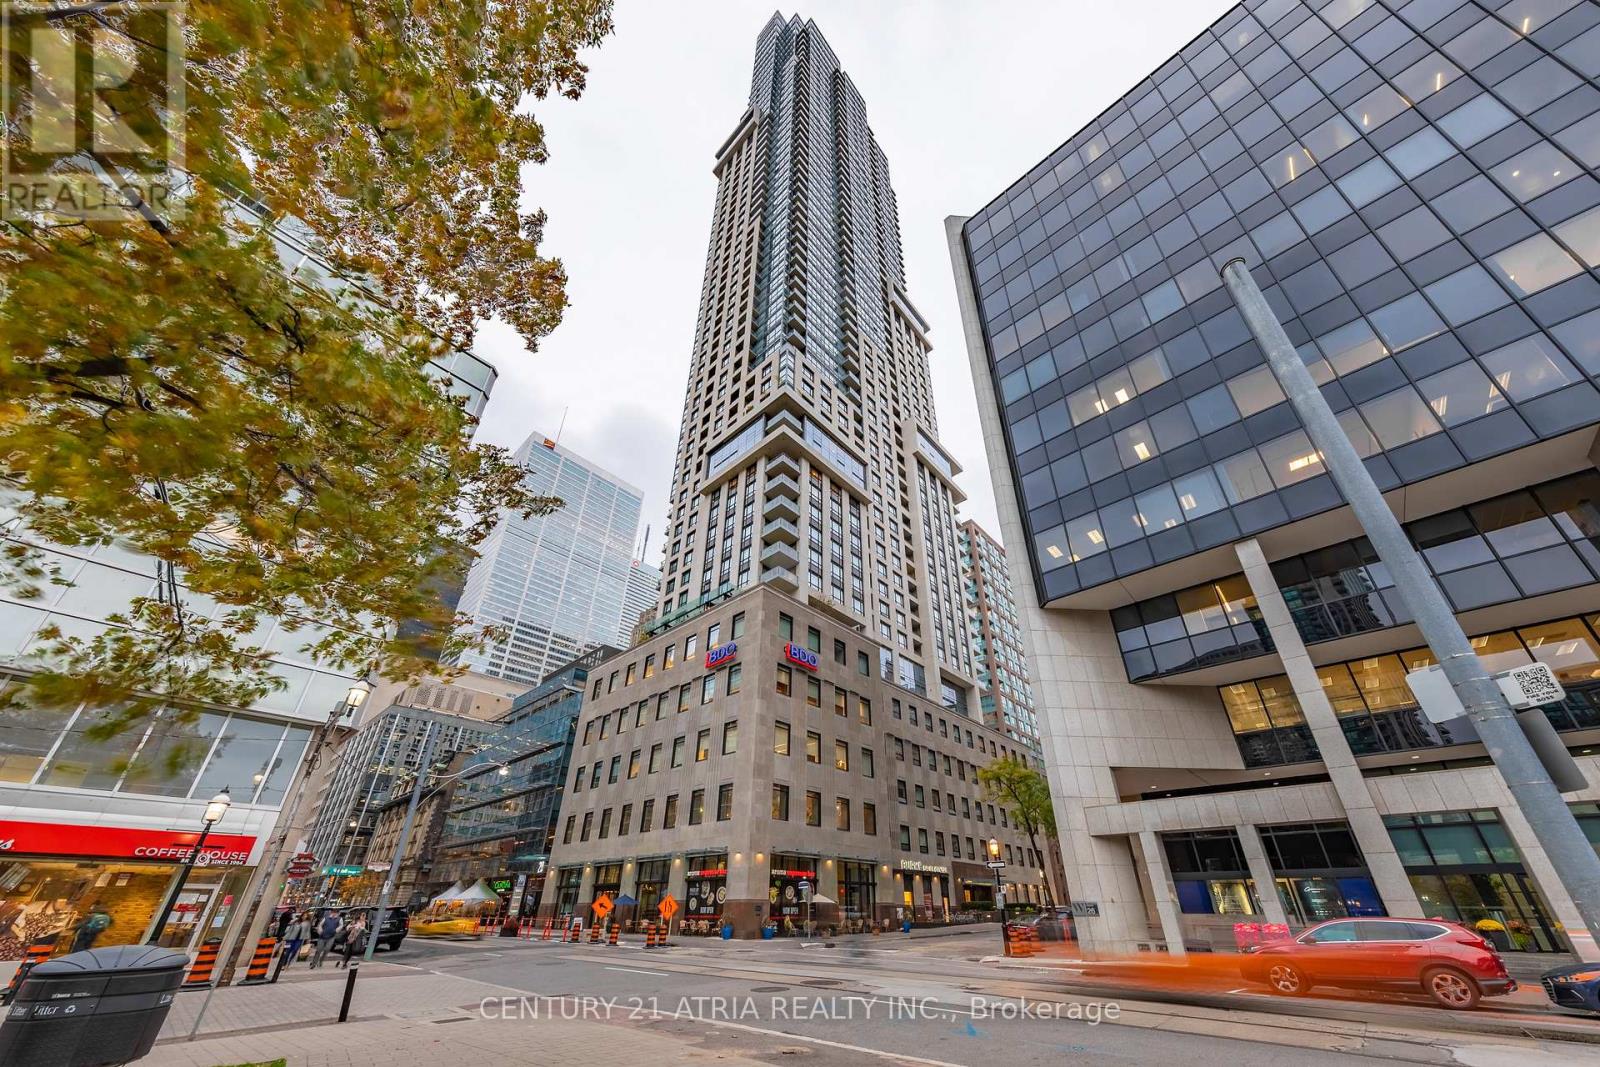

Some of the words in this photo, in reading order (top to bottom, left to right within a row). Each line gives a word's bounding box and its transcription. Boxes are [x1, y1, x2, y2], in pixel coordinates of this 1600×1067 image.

[709, 642, 737, 663] BDO
[791, 643, 817, 665] BDO
[134, 846, 195, 859] COFFEE
